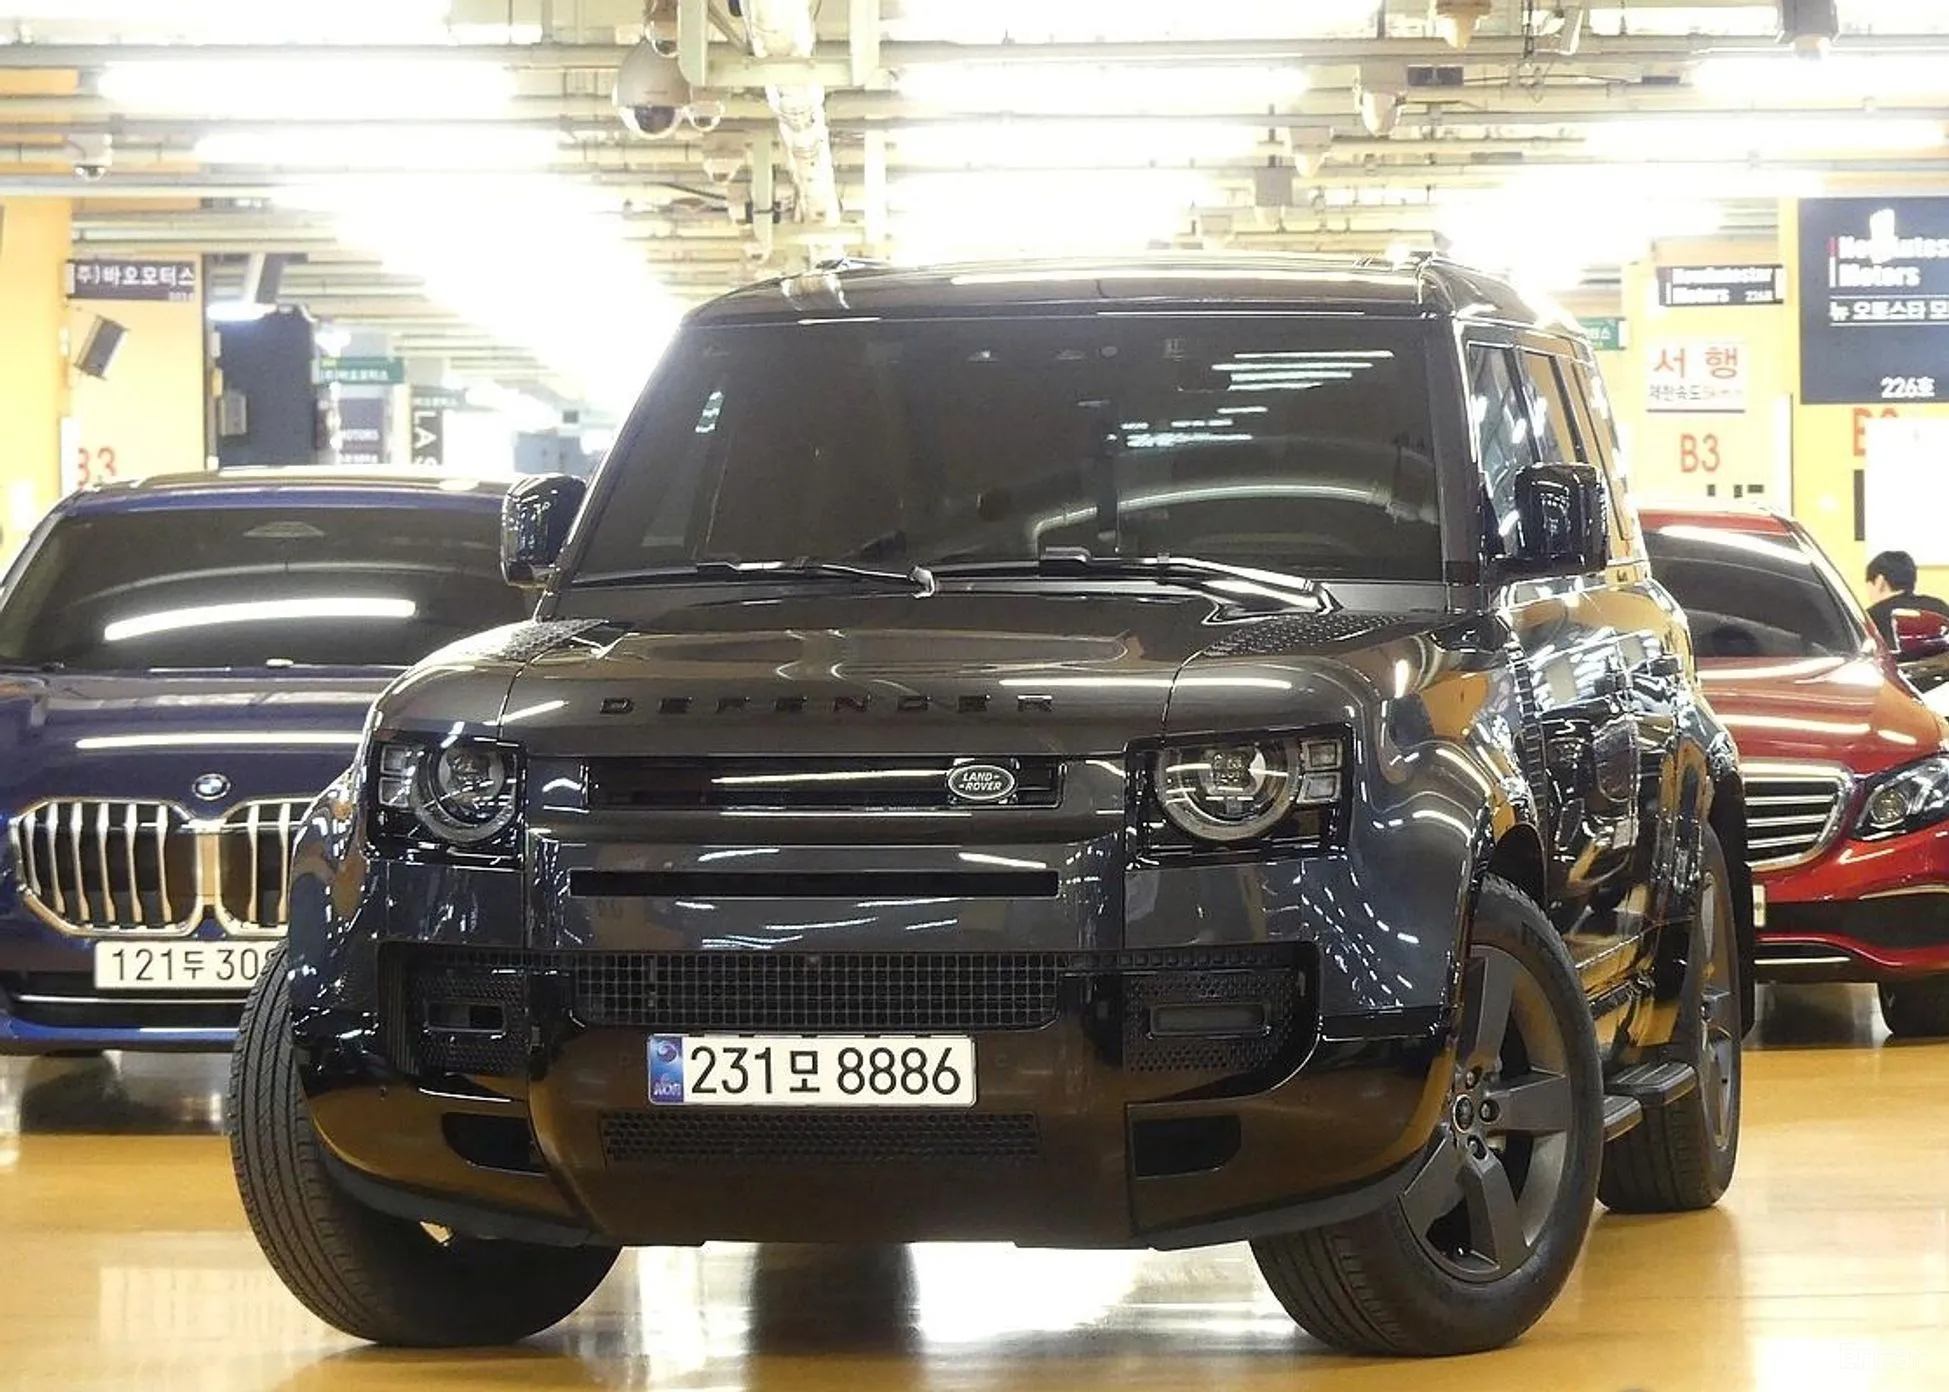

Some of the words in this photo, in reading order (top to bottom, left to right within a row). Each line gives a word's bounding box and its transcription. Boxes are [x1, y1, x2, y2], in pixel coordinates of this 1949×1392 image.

[1680, 433, 1721, 473] B3
[599, 695, 1053, 714] DEFENDER
[963, 771, 993, 782] LAND
[965, 782, 1002, 791] ROVER
[112, 948, 205, 981] 121두
[690, 1046, 820, 1094] 231모
[837, 1047, 961, 1095] 8886
